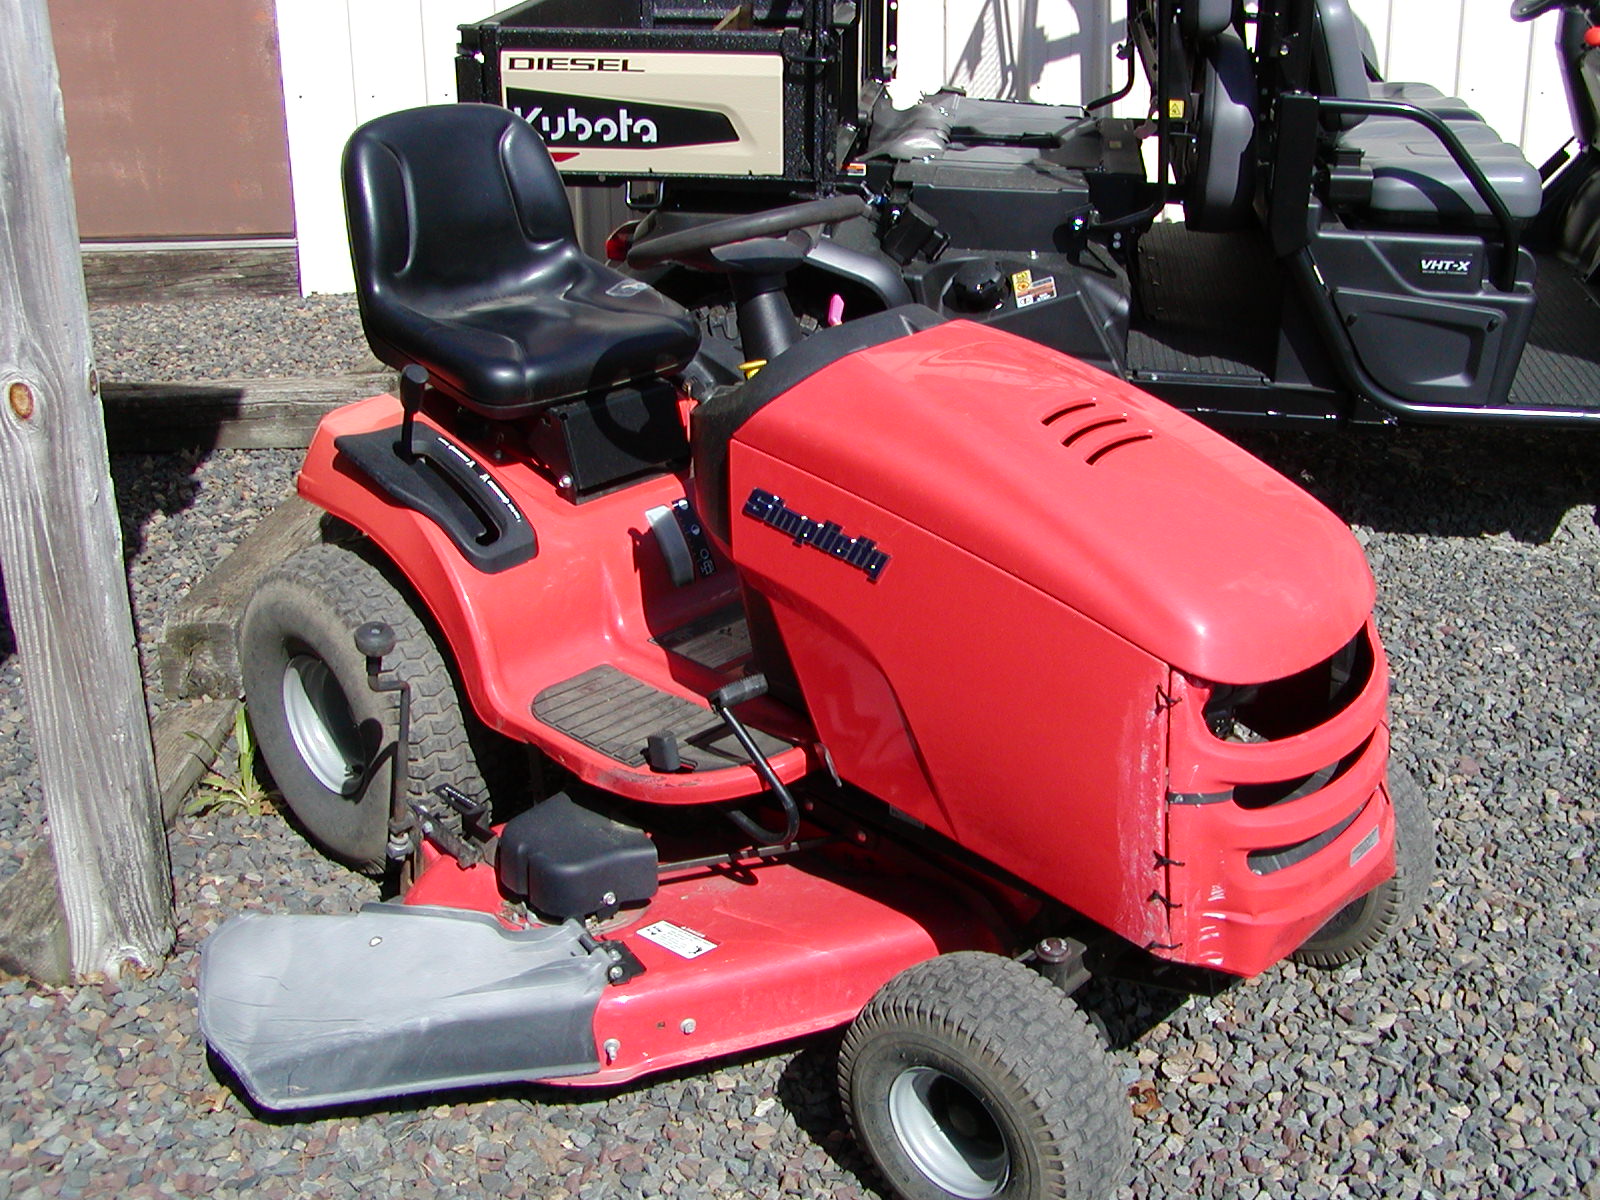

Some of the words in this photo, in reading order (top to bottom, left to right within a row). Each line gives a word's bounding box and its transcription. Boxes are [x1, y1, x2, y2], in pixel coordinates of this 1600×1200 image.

[508, 57, 645, 72] DIESEL
[1421, 259, 1471, 271] VHT-X
[742, 487, 892, 583] Simplicity
